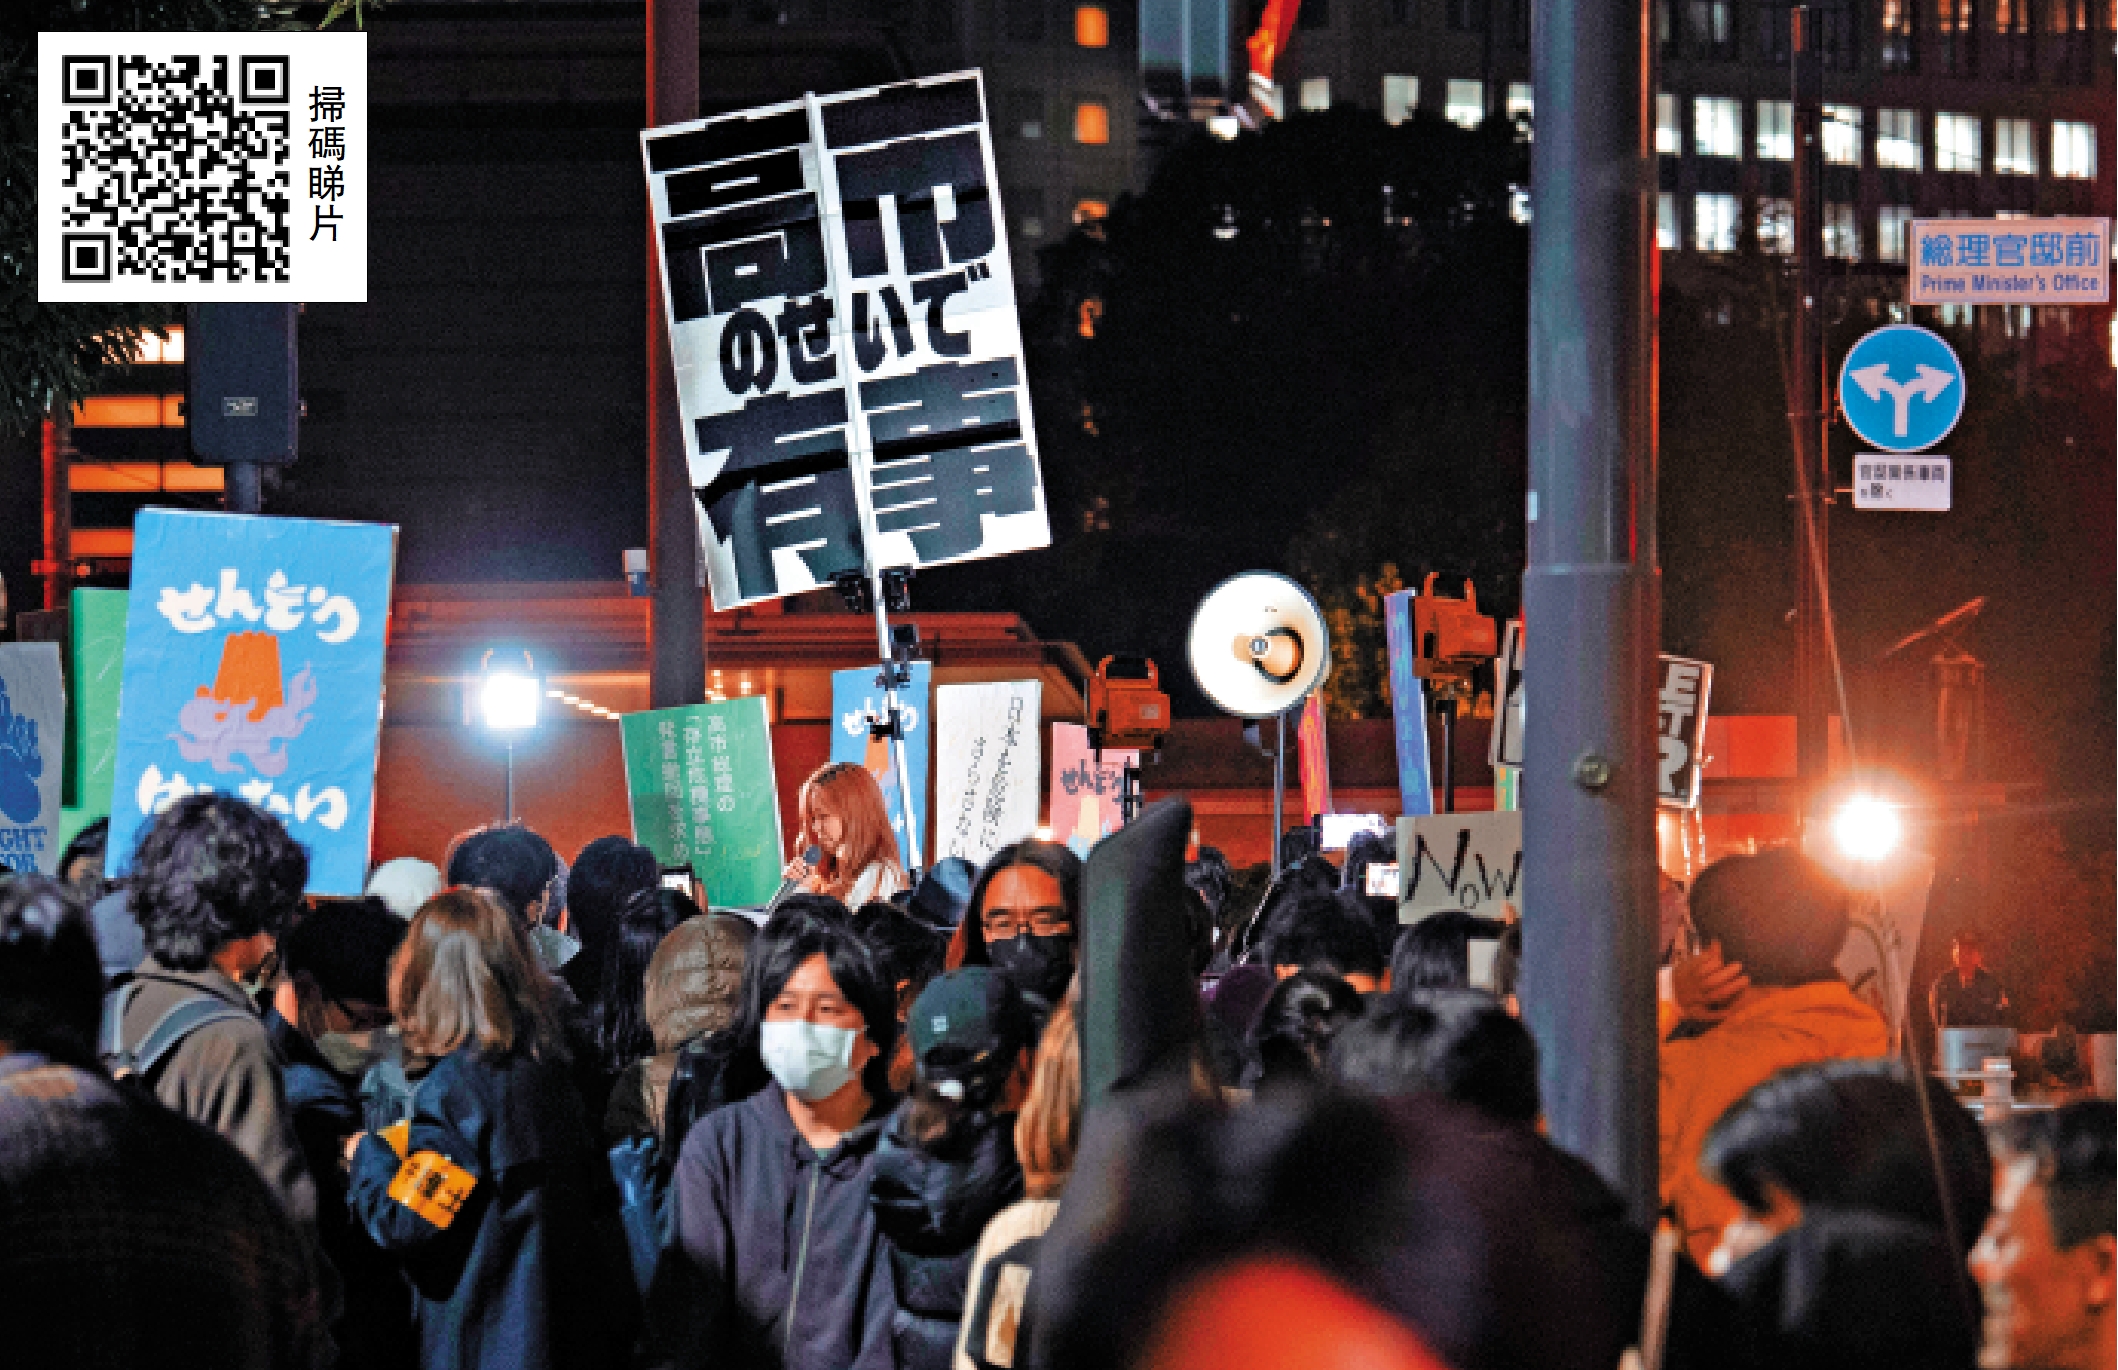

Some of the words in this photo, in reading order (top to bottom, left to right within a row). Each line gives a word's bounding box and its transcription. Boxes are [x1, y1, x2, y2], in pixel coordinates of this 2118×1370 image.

[650, 76, 996, 324] 高市
[1920, 232, 2101, 267] 総理官邸前
[719, 262, 991, 395] のせいで
[1922, 275, 1965, 293] Prime
[1972, 274, 2046, 293] Minister's
[2053, 275, 2098, 291] Office
[694, 356, 1038, 600] 有事
[156, 568, 360, 643] せんそう
